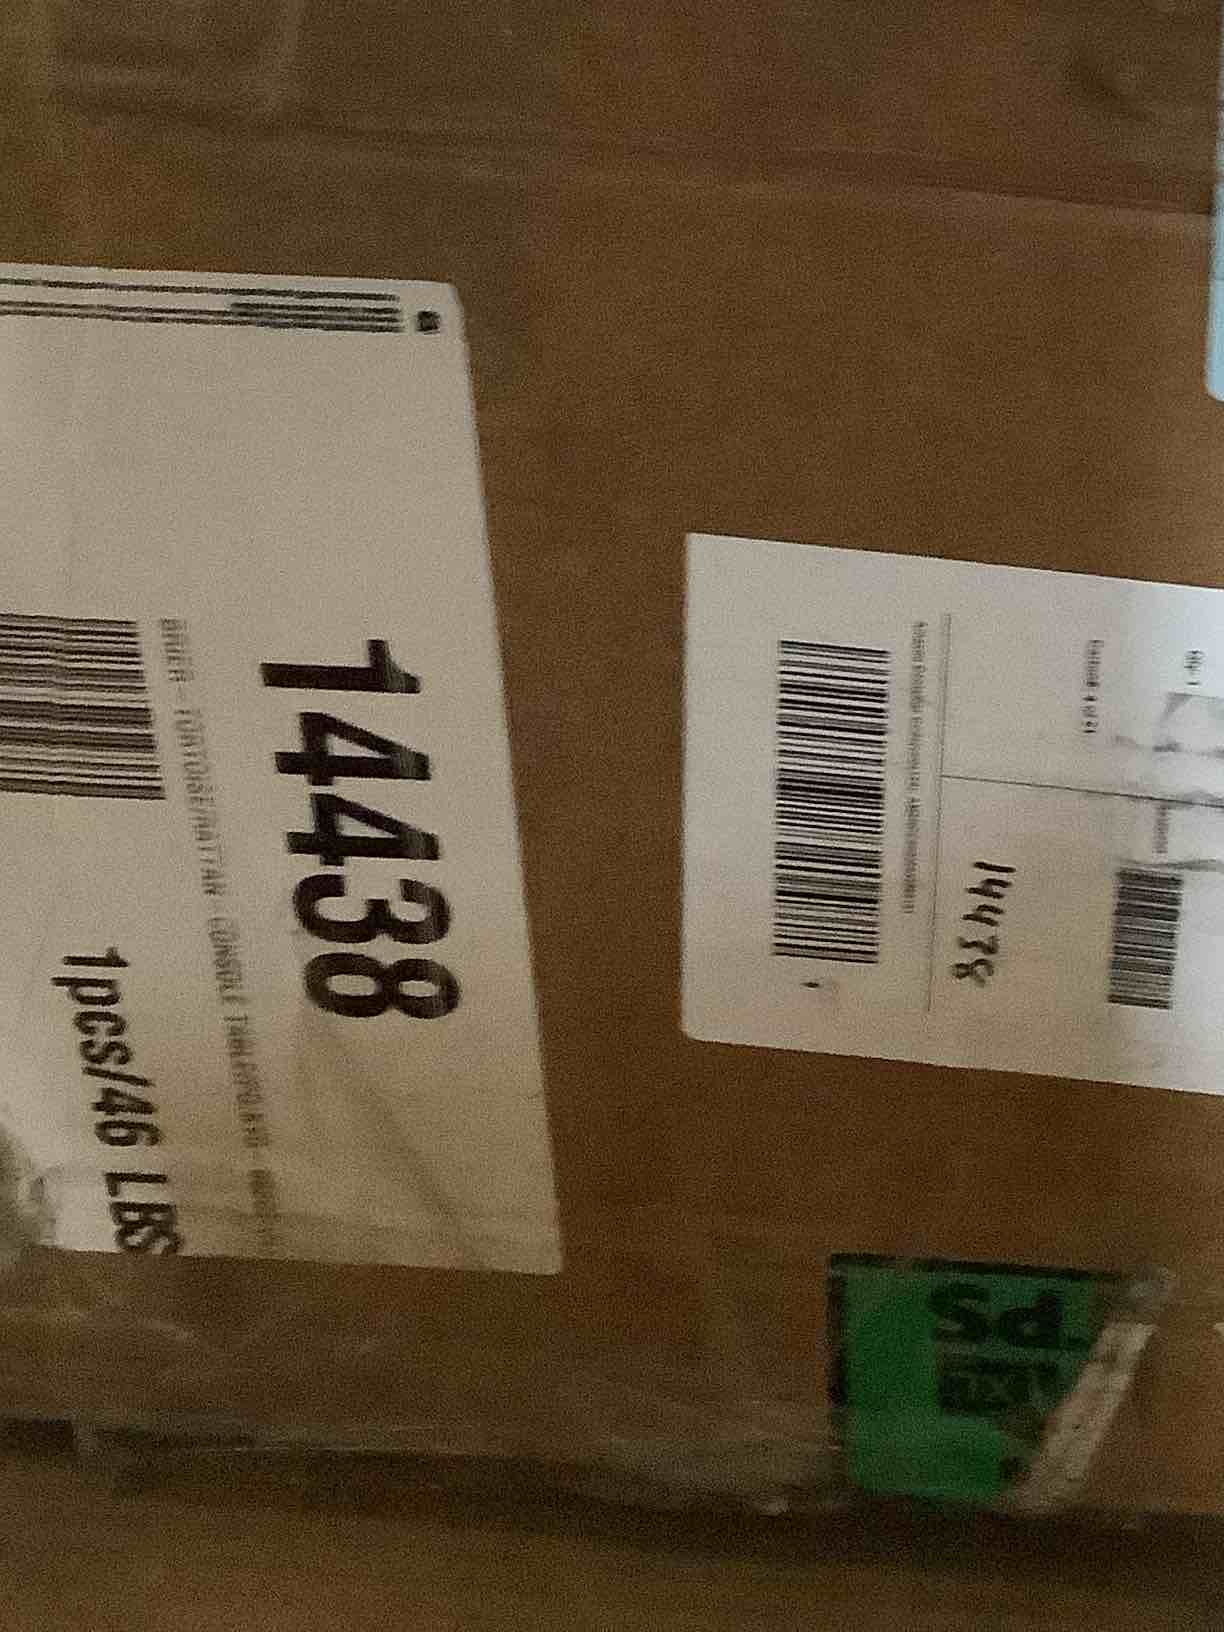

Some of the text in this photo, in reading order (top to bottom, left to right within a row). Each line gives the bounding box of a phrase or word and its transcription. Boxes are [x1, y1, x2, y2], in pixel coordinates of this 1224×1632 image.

[261, 640, 462, 1020] 14438
[953, 858, 1018, 988] 14438
[51, 946, 165, 1147] 1pcs/46
